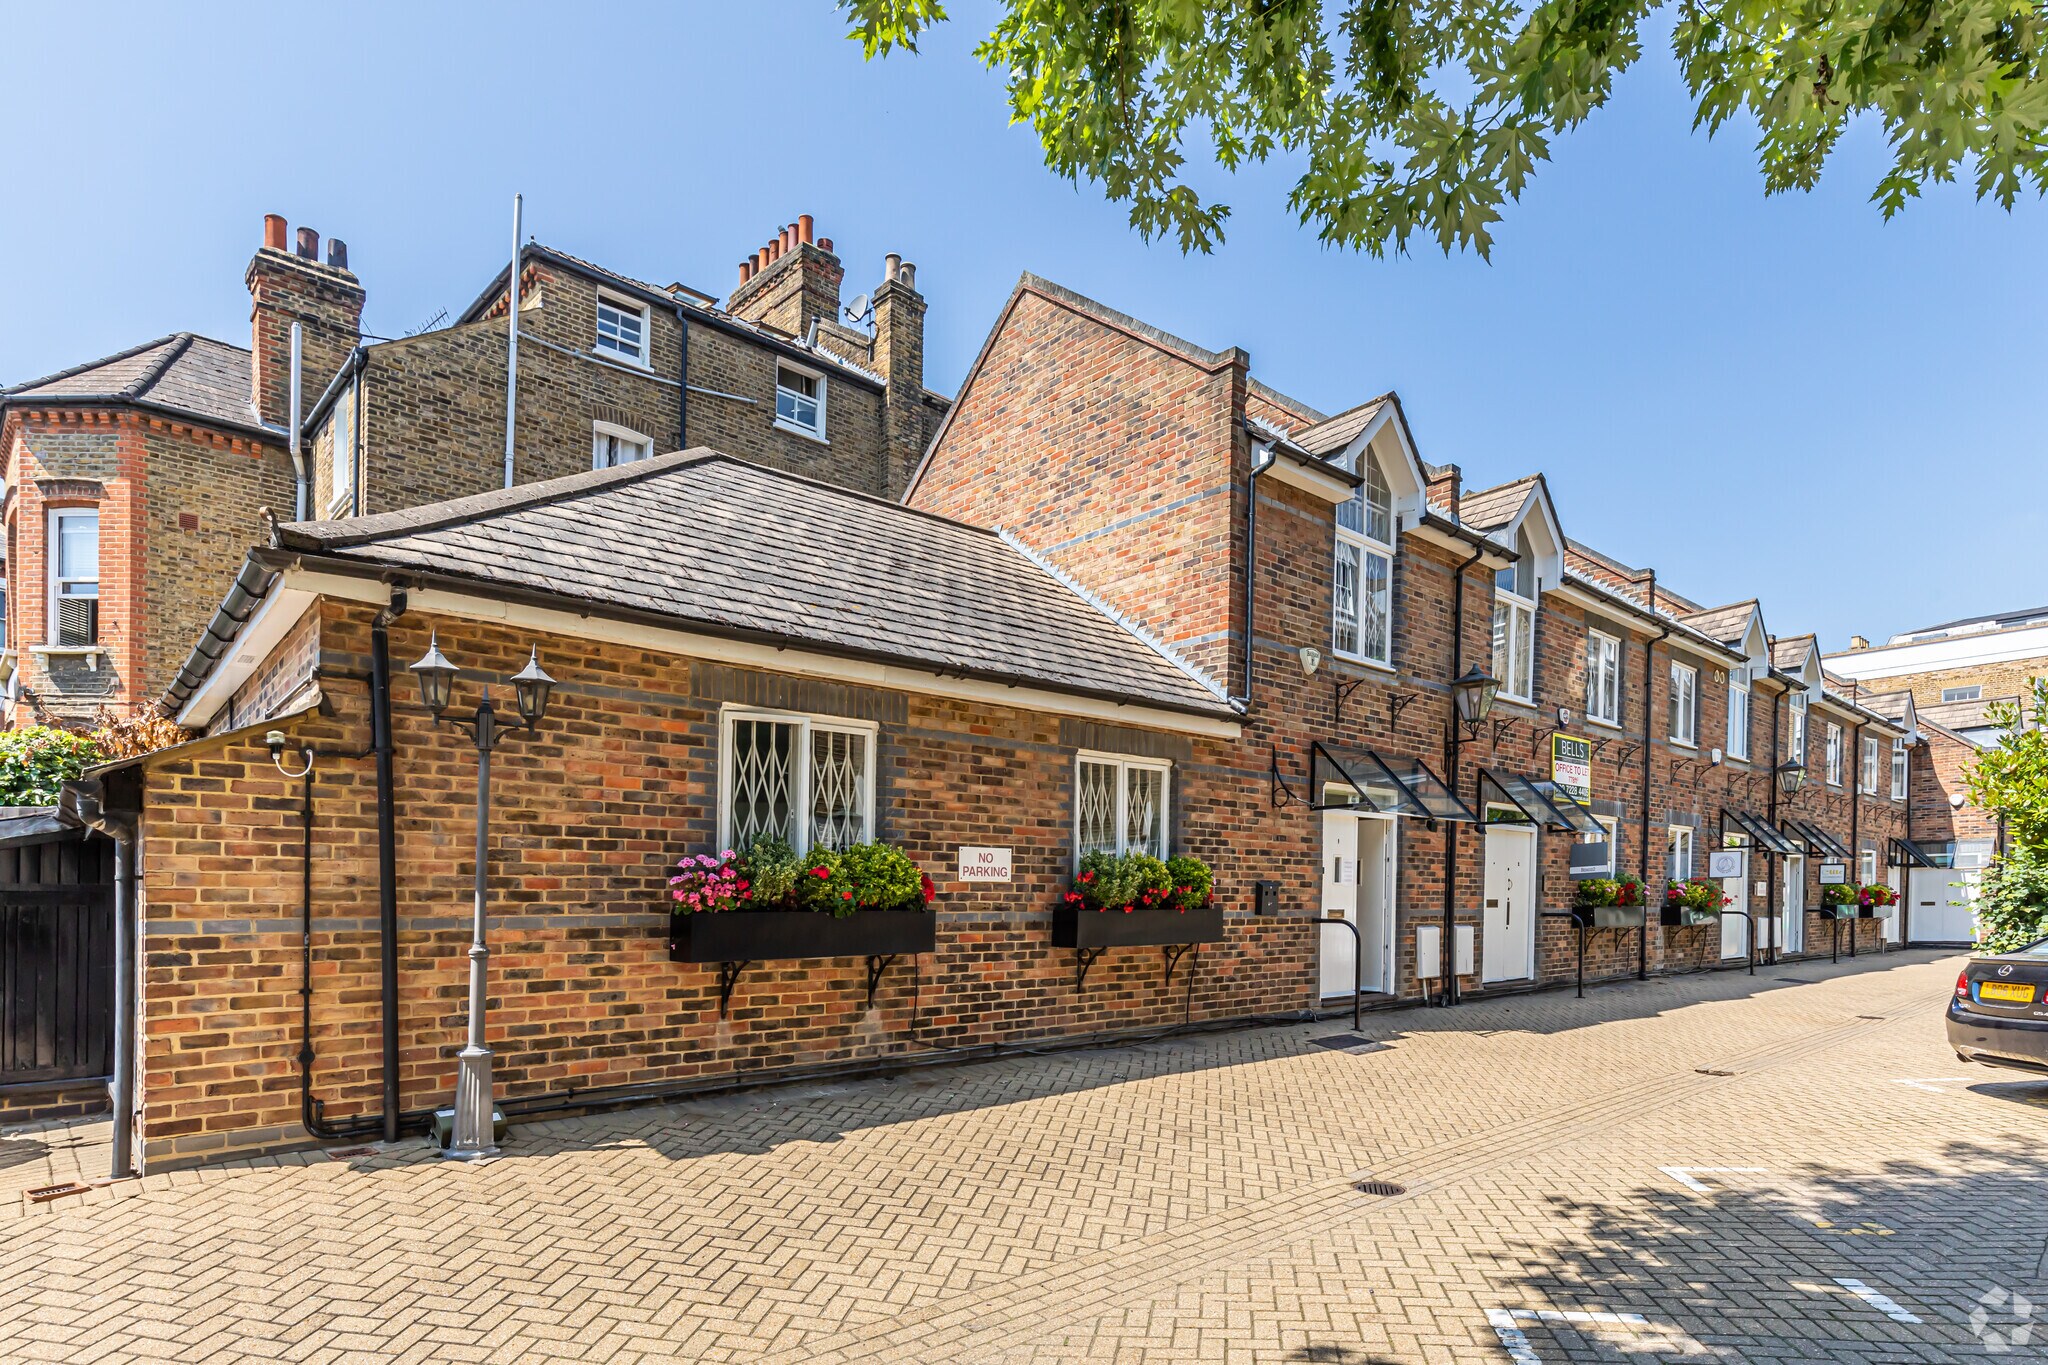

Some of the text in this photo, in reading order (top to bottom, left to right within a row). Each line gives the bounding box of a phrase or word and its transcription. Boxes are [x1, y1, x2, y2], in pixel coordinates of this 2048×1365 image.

[1561, 740, 1585, 758] BELLS
[1555, 762, 1590, 776] OFFICE TO LET
[978, 852, 994, 864] NO
[962, 865, 1008, 878] PARKING
